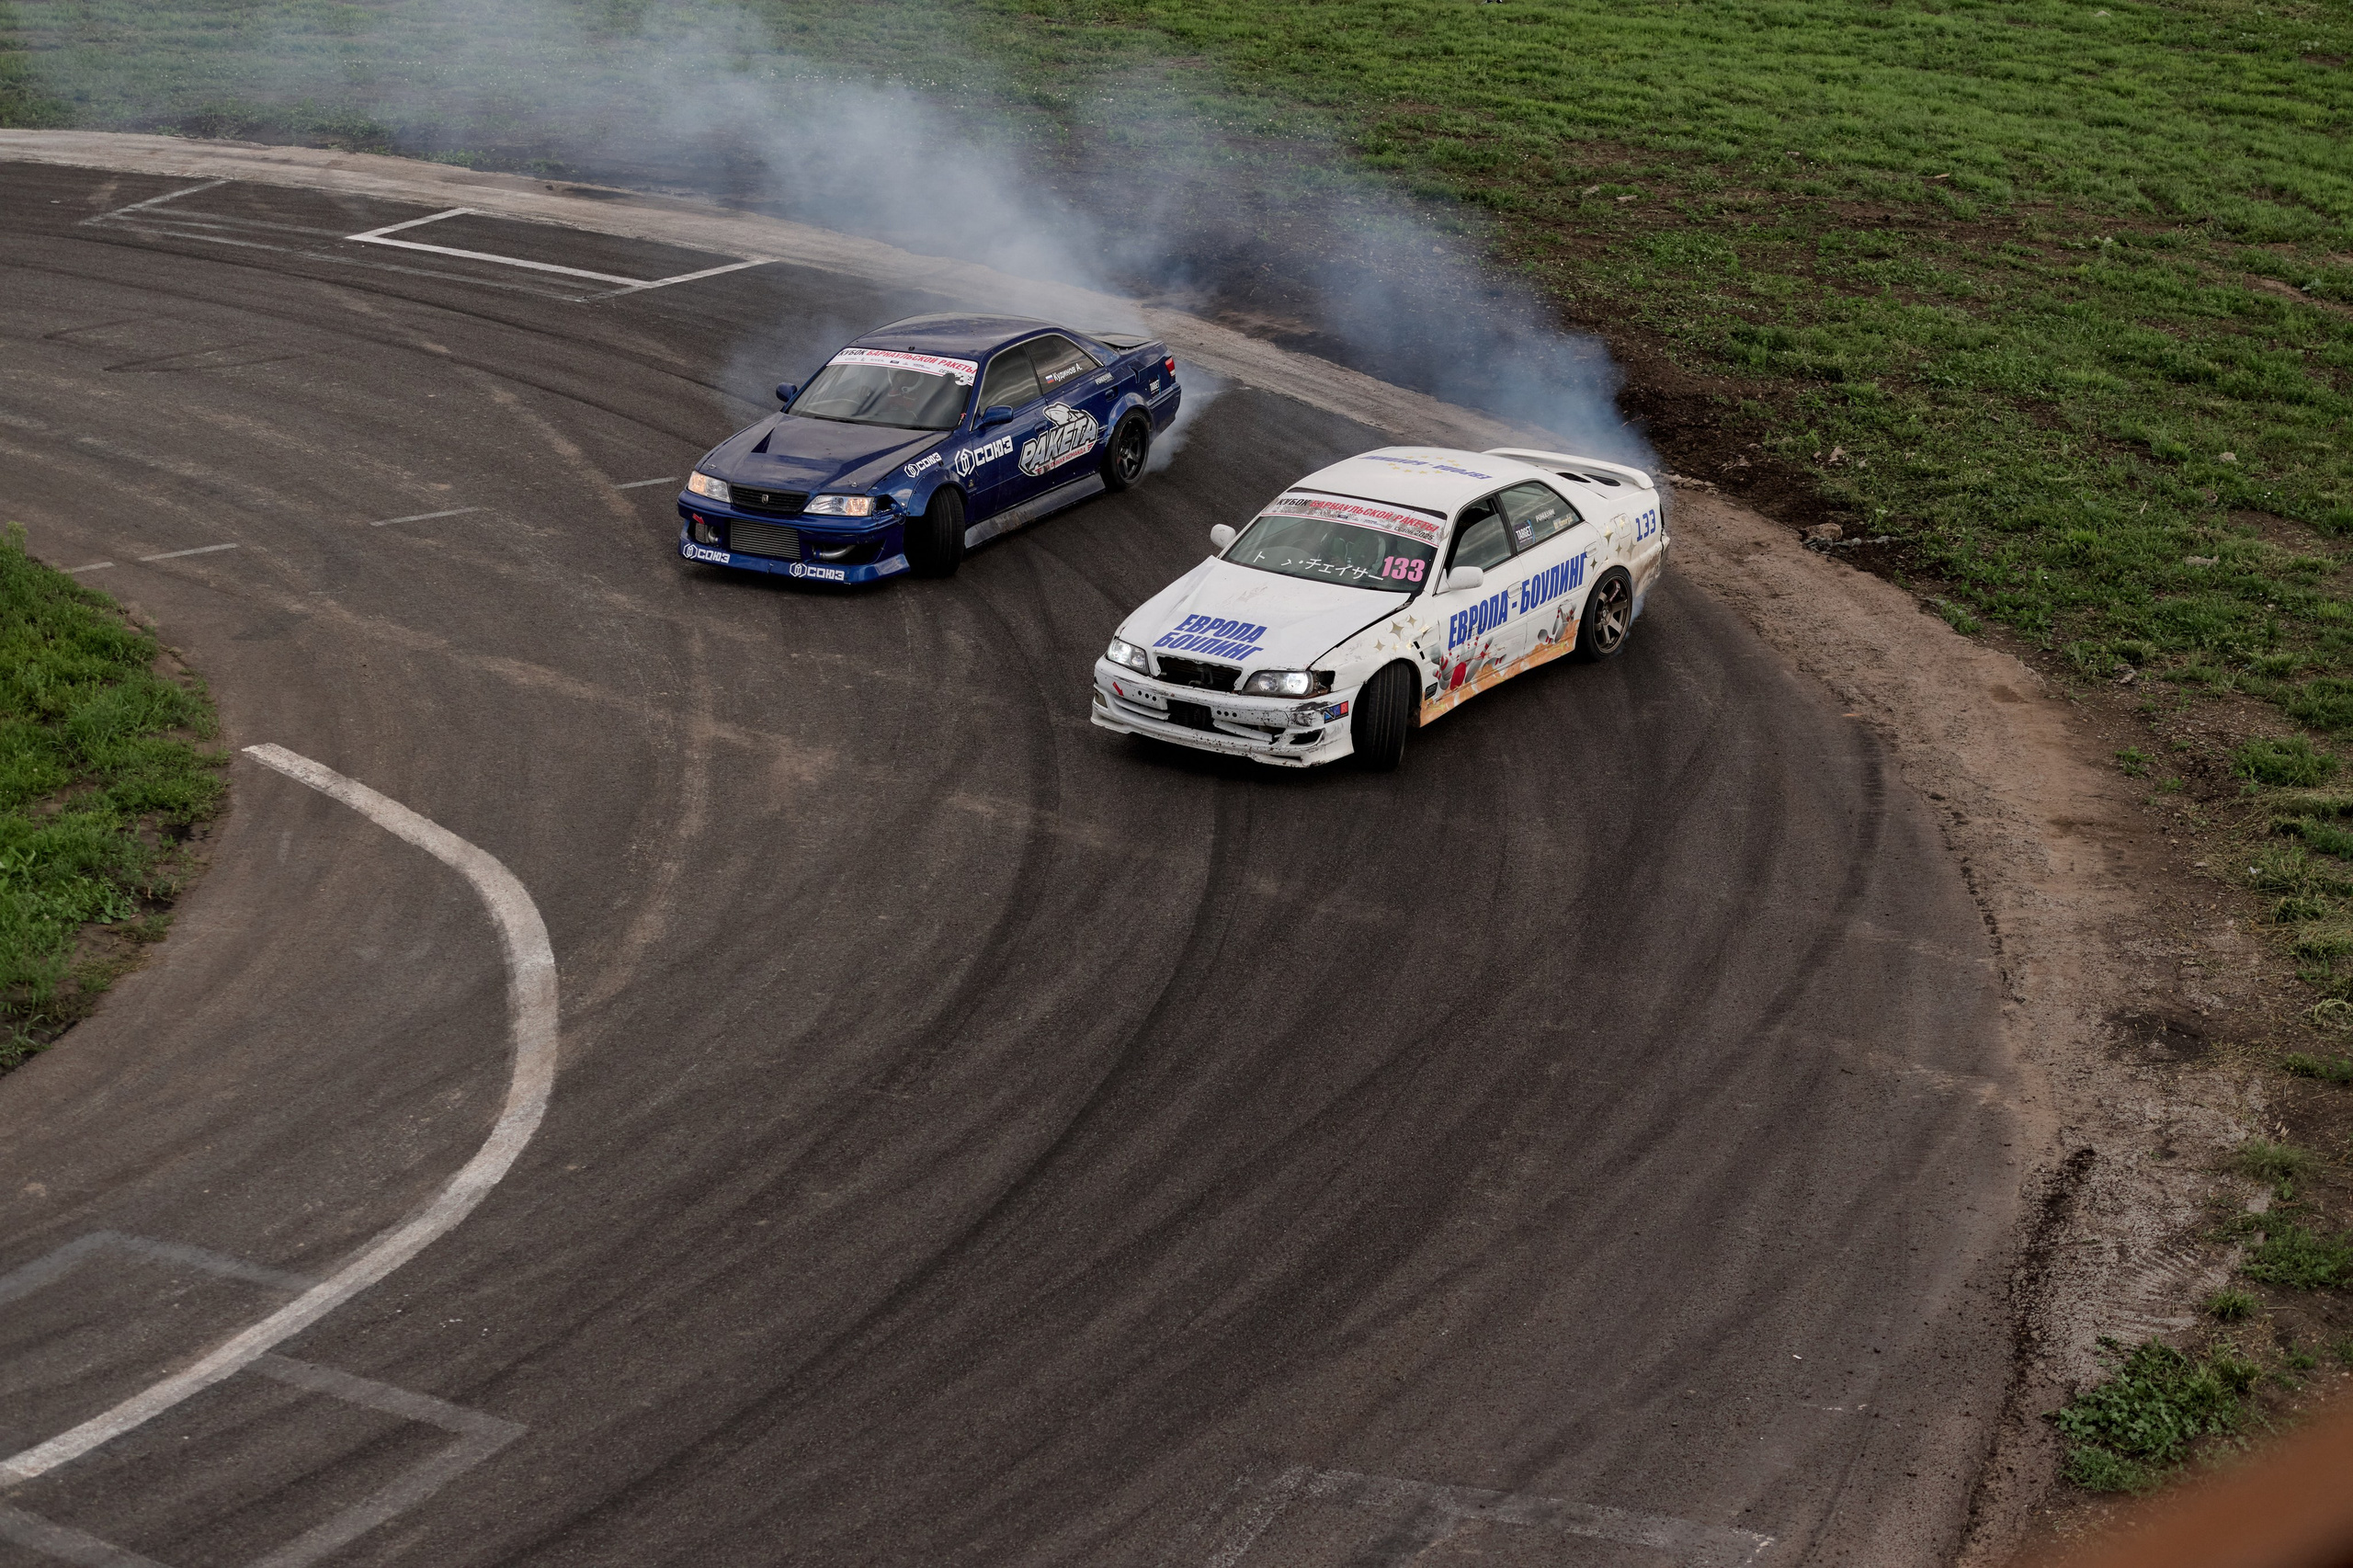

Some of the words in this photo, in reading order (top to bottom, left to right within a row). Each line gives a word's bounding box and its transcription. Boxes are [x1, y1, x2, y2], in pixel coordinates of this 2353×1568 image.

[866, 349, 938, 364] БАРНАУЛЬСКОЙ
[938, 359, 978, 374] РАКЕТЫ
[1052, 366, 1076, 382] Кудинов
[976, 435, 1014, 467] СОЮЗ
[1020, 418, 1097, 472] РАКЕТА
[918, 451, 941, 471] СОЮЗ
[1278, 498, 1311, 507] КУБОК
[1309, 499, 1394, 520] БАРНАУЛЬСКОЙ
[1393, 515, 1439, 532] РАКЕТЫ
[1635, 508, 1656, 542] 133
[1414, 529, 1435, 540] 2025
[697, 549, 731, 563] СОЮЗ
[1381, 556, 1426, 583] 133
[807, 565, 845, 581] СОЮЗ
[1448, 589, 1508, 651] ЕВРОПА
[1519, 551, 1588, 615] БОУЛИНГ
[1174, 614, 1267, 643] ЕВРОПА
[1153, 631, 1264, 661] БОУЛИНГ
